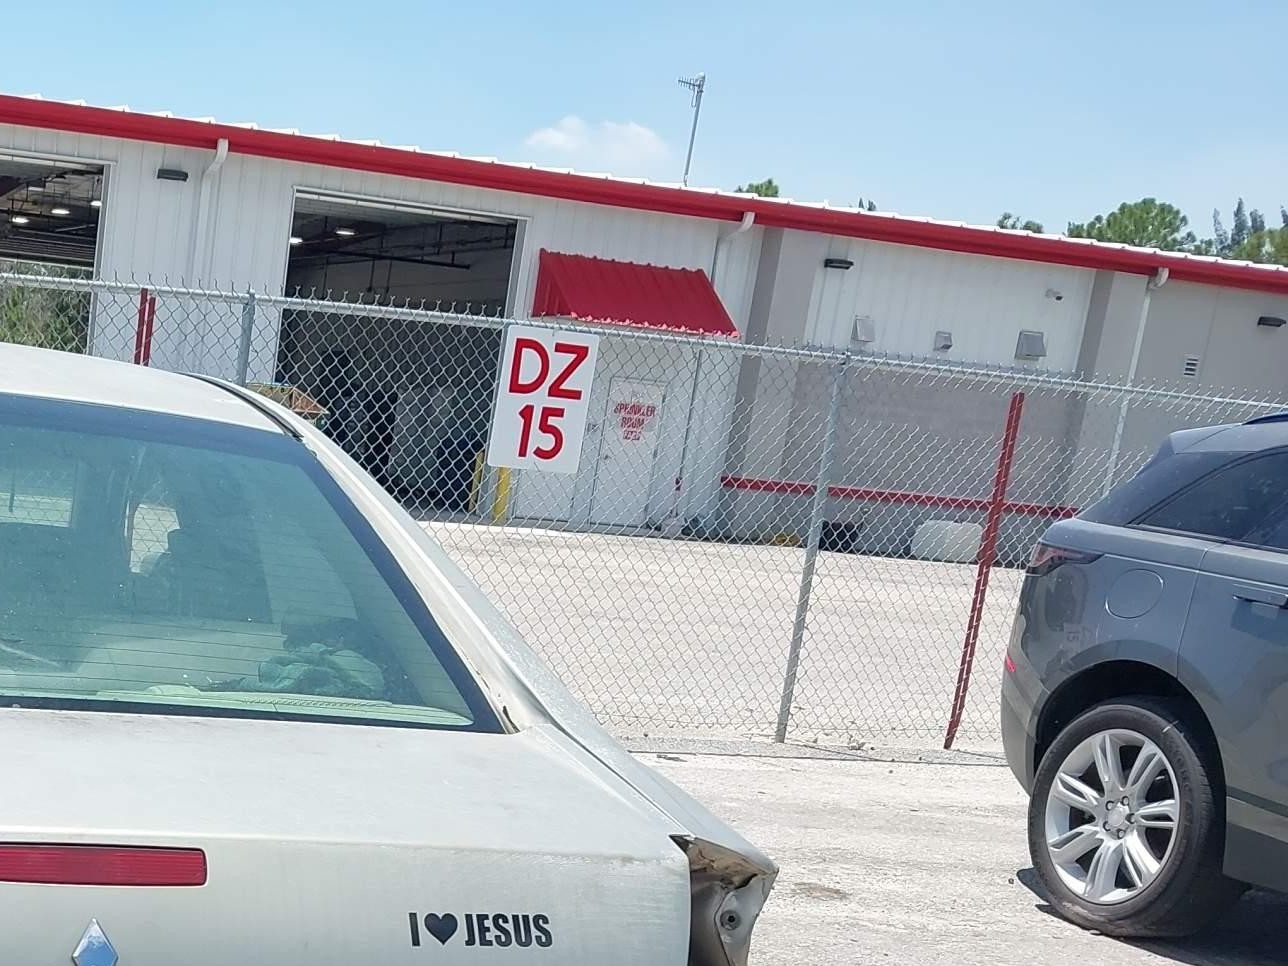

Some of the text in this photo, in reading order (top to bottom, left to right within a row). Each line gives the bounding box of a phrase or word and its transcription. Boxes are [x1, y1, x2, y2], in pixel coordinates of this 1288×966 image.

[509, 337, 589, 400] DZ
[518, 404, 565, 460] 15
[464, 913, 553, 947] JESUS
